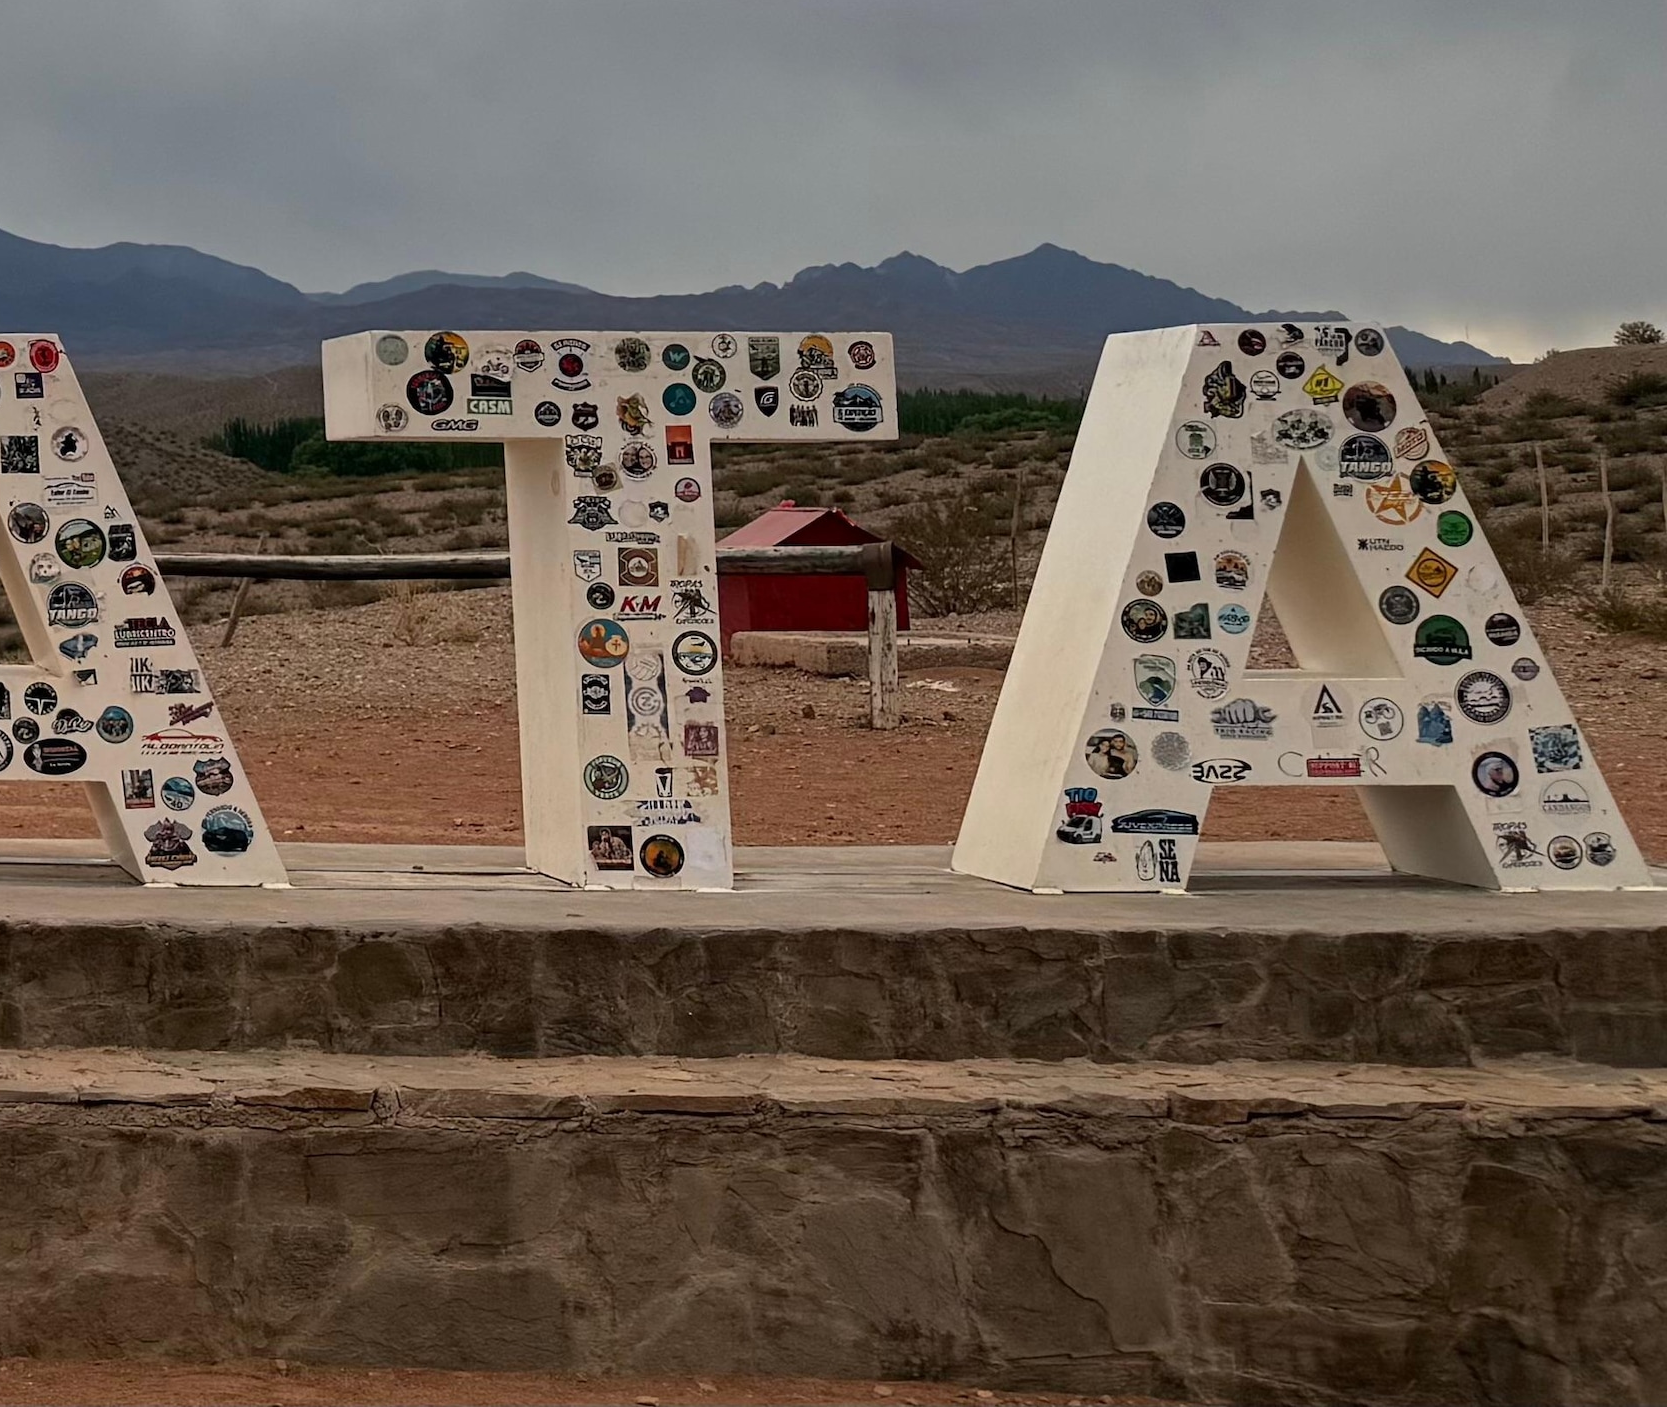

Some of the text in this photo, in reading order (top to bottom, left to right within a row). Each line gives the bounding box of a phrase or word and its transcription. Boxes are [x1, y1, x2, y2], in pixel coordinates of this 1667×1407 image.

[470, 401, 510, 415] CASM
[1340, 461, 1392, 474] TANGO
[48, 607, 97, 620] TANGO
